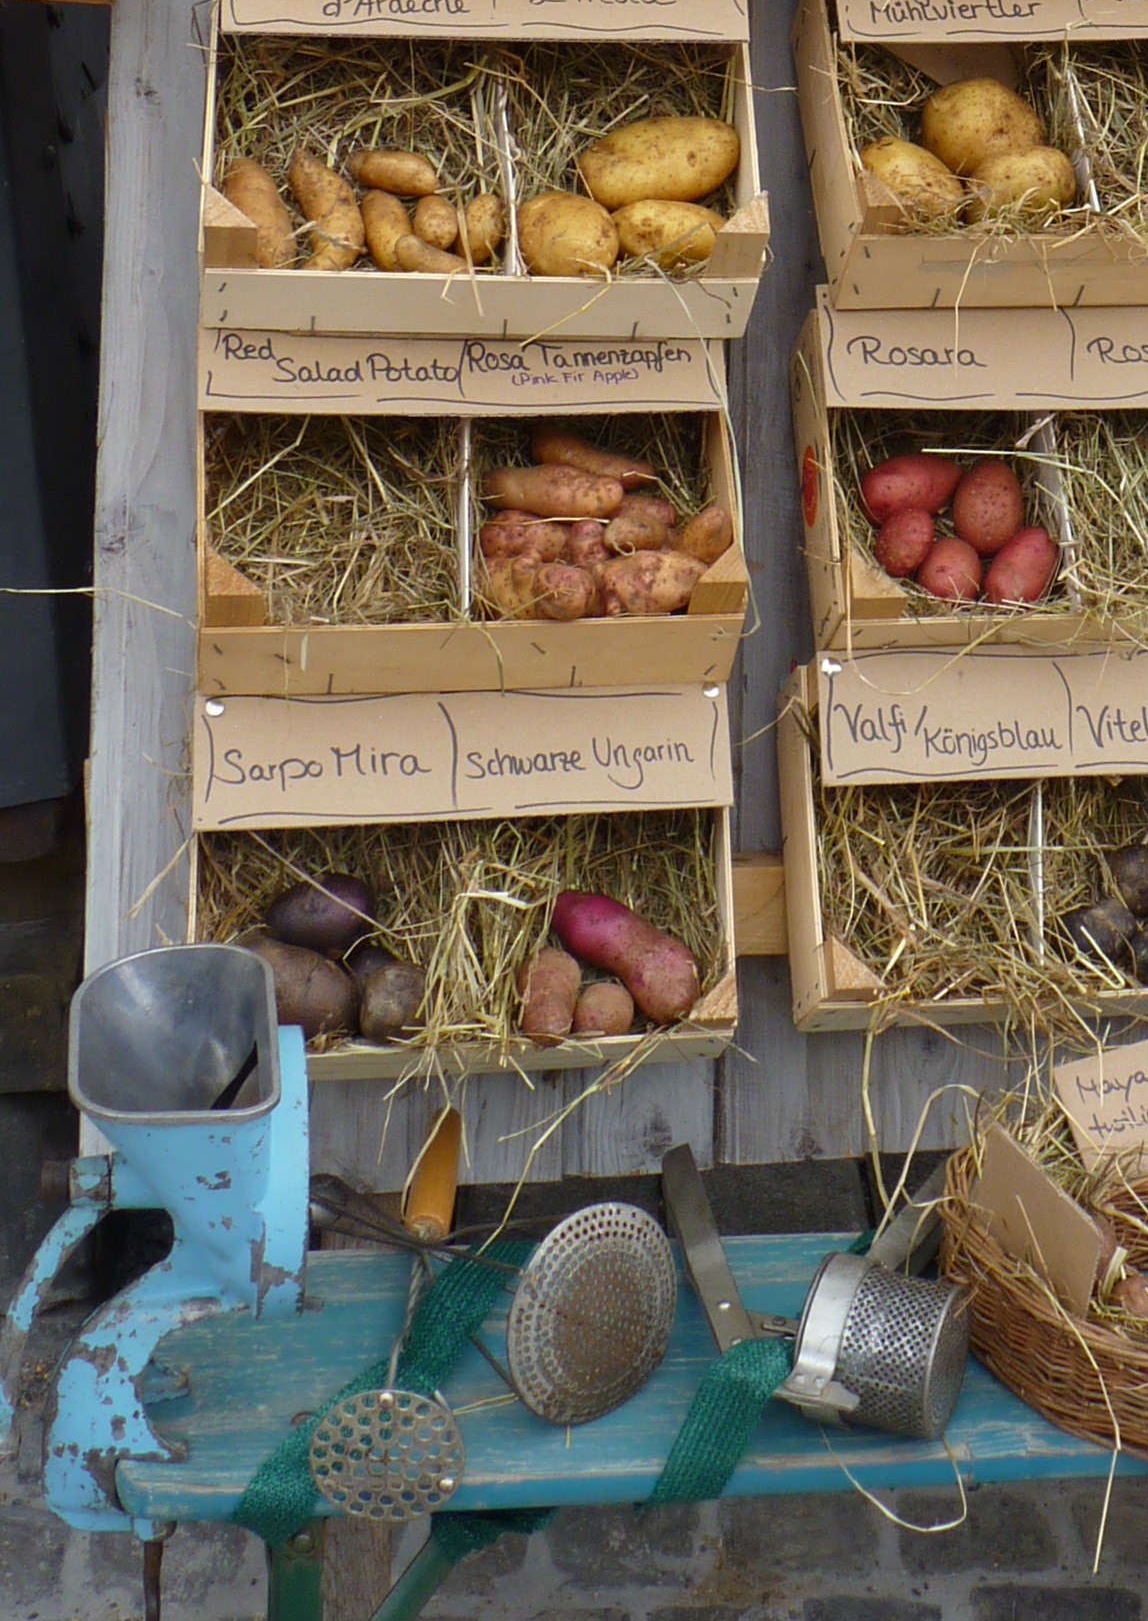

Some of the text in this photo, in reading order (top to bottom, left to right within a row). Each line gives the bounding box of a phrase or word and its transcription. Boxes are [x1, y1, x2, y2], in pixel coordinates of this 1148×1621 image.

[223, 333, 278, 362] Red
[467, 342, 692, 373] Rosa Tannenzapfen
[846, 335, 987, 368] Rosara
[273, 354, 460, 384] Salad Potato
[511, 368, 639, 386] (Pink Fir Apple)
[218, 743, 431, 791] Sarpo Mira
[465, 737, 695, 789] Schwarze Ungarin
